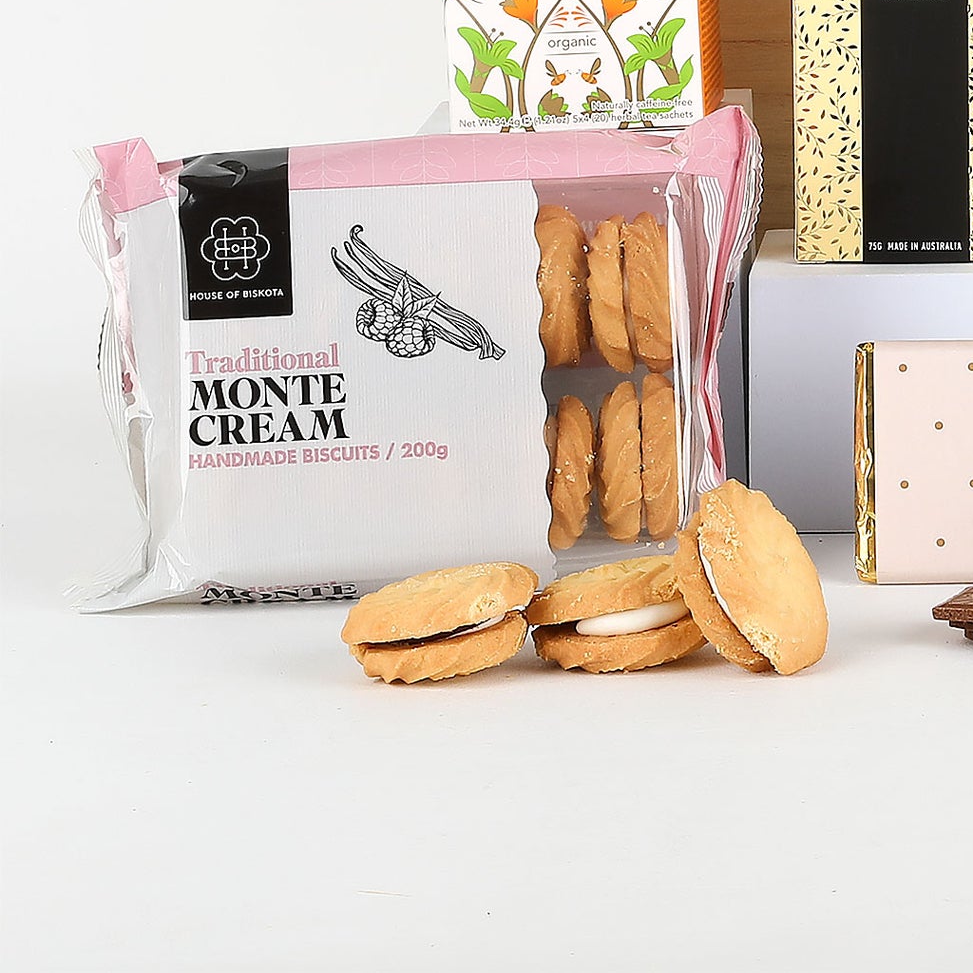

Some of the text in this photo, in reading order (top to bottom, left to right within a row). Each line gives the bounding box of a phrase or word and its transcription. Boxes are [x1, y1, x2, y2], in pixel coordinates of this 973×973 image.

[548, 35, 596, 50] organic
[592, 99, 693, 110] Naturally caffeine-free
[459, 119, 475, 128] Net
[478, 119, 492, 127] Wt
[494, 118, 520, 128] 34.4g
[533, 115, 570, 127] (1.21oz)
[573, 115, 589, 123] 5x4
[592, 114, 609, 124] (20)
[611, 113, 640, 122] herbal
[660, 111, 693, 119] sachets
[868, 241, 962, 251] 75G MADE IN AUSTRALIA
[190, 288, 284, 301] HOUSE OF BISKOTA
[185, 343, 340, 375] Traditional
[190, 373, 347, 411] MONTE
[188, 409, 350, 447] CREAM
[188, 441, 449, 469] HANDMADE BISCUITS / 200g
[202, 583, 359, 600] MONTE
